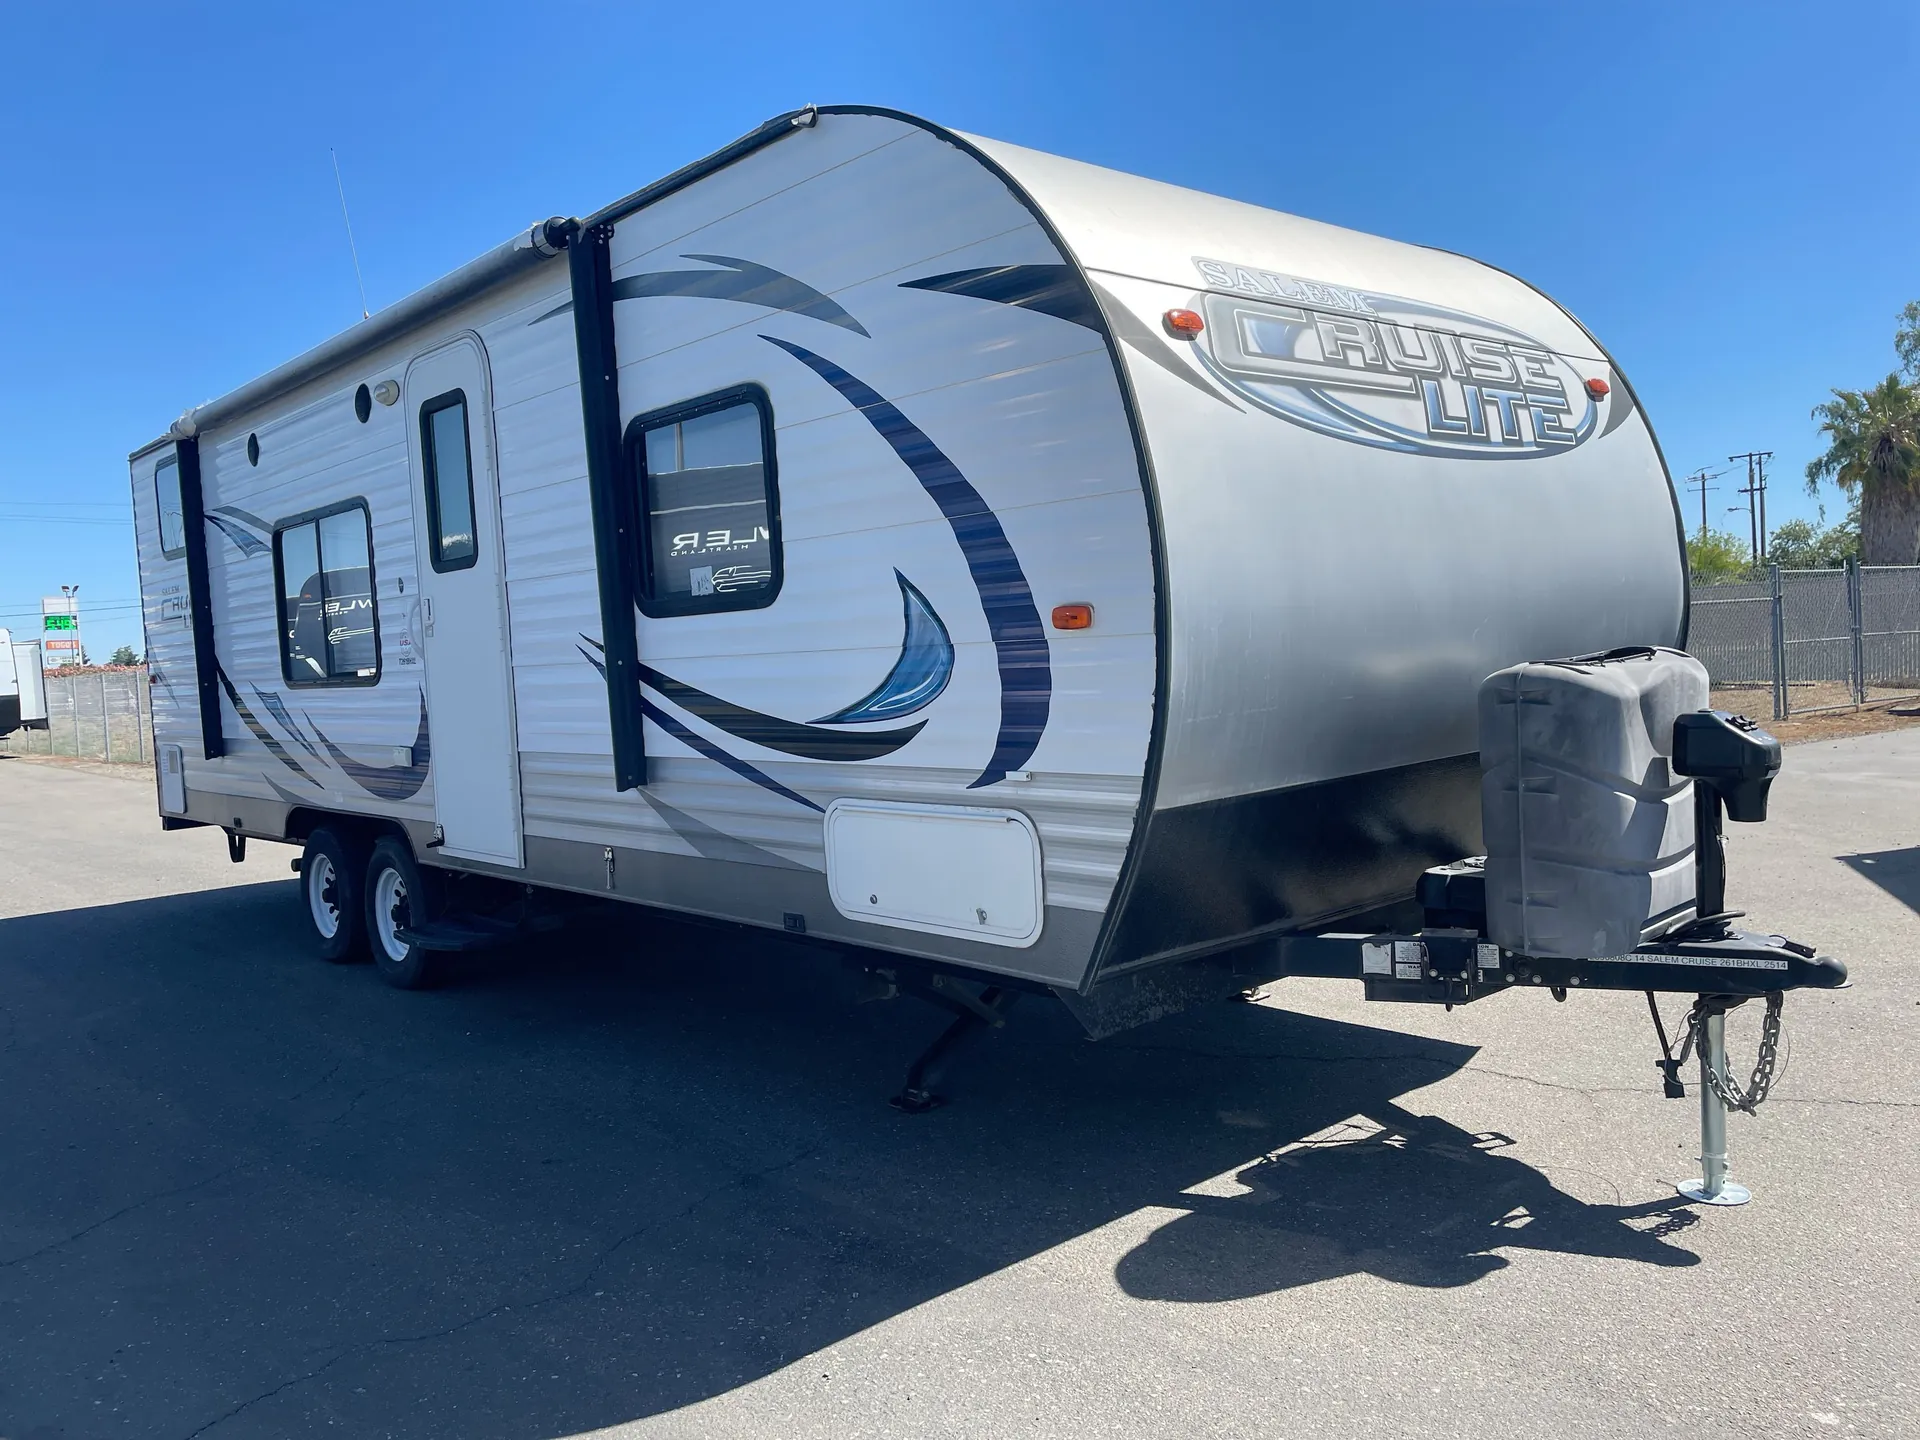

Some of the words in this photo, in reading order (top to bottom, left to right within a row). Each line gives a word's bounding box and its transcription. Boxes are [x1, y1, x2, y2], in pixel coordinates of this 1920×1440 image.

[1197, 257, 1376, 316] SALEM
[1204, 292, 1565, 397] CRUISE
[1419, 373, 1578, 447] LITE
[1635, 954, 1645, 963] 14
[1646, 955, 1680, 964] SALEM
[1682, 957, 1718, 966] CRUISE
[1719, 959, 1762, 968] 261BHXL
[1764, 961, 1787, 970] 2514
